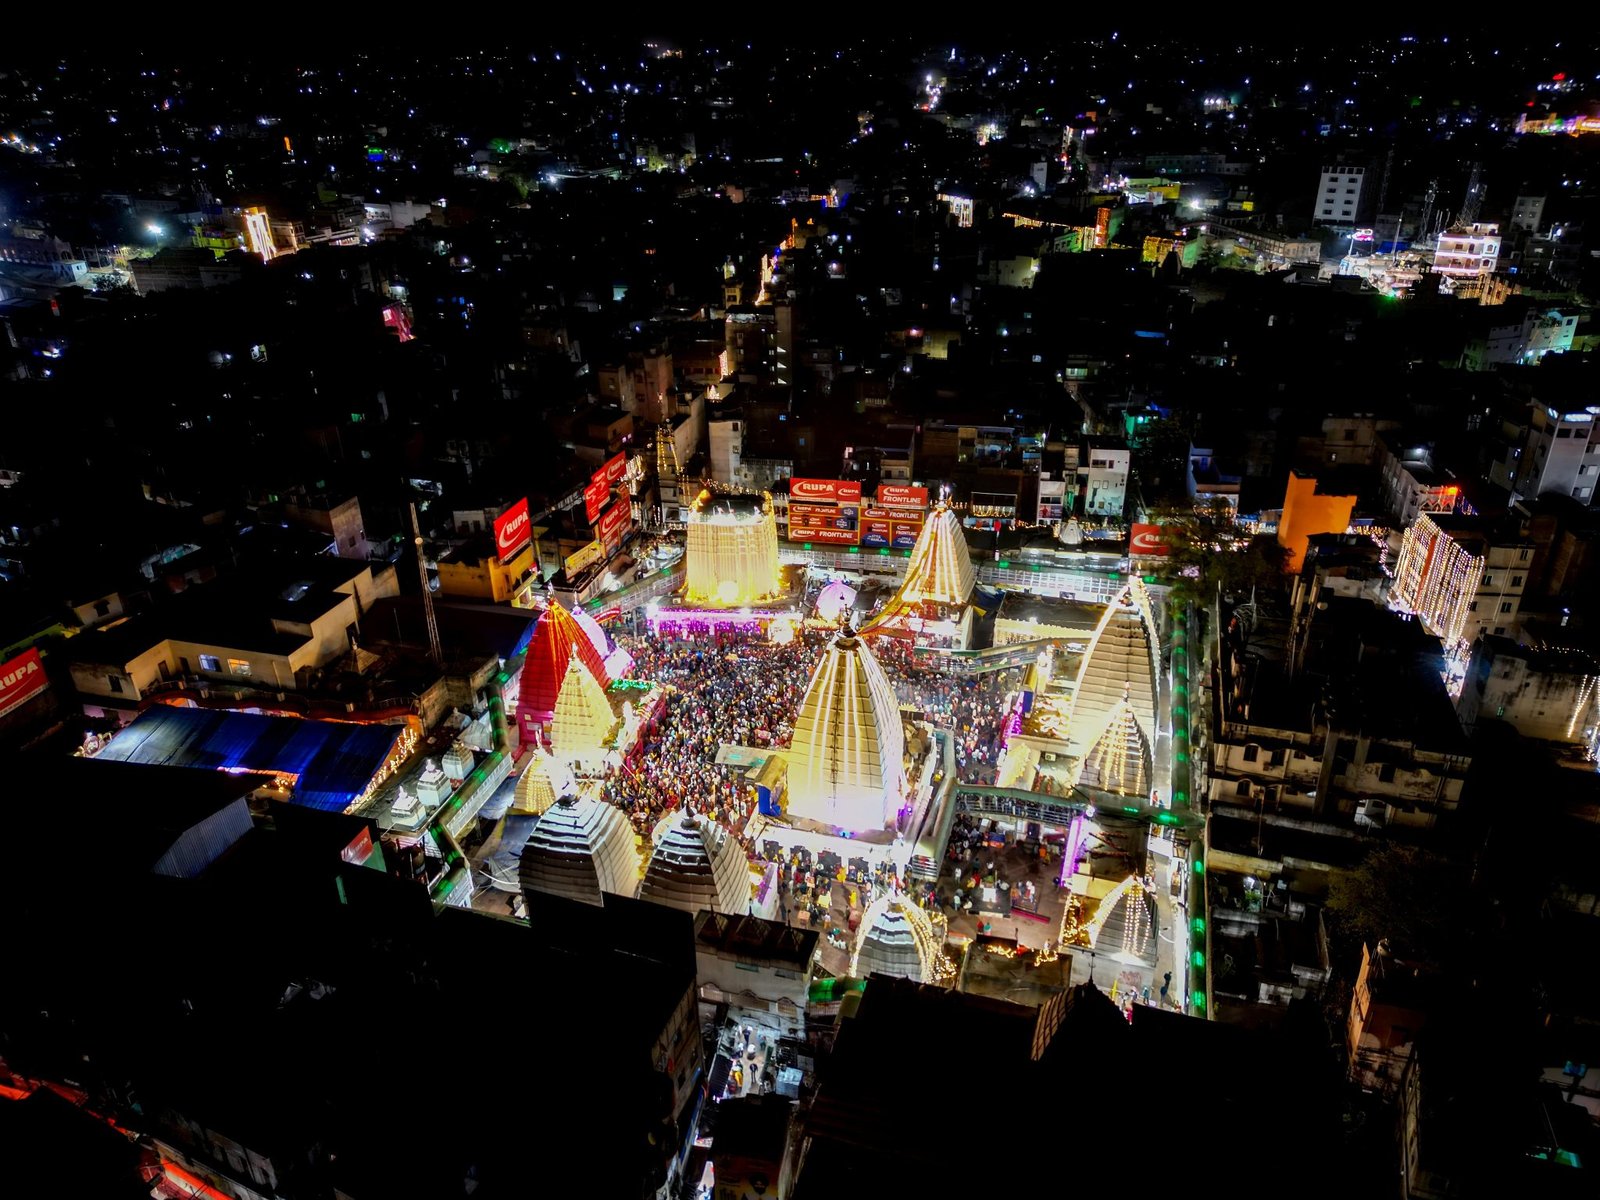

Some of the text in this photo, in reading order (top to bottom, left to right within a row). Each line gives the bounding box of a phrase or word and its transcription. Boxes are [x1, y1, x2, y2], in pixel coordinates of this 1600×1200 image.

[802, 483, 834, 492] RUPA
[883, 496, 921, 504] FRONTLINE
[889, 511, 919, 519] FRONTLINE
[506, 511, 529, 535] RUPA
